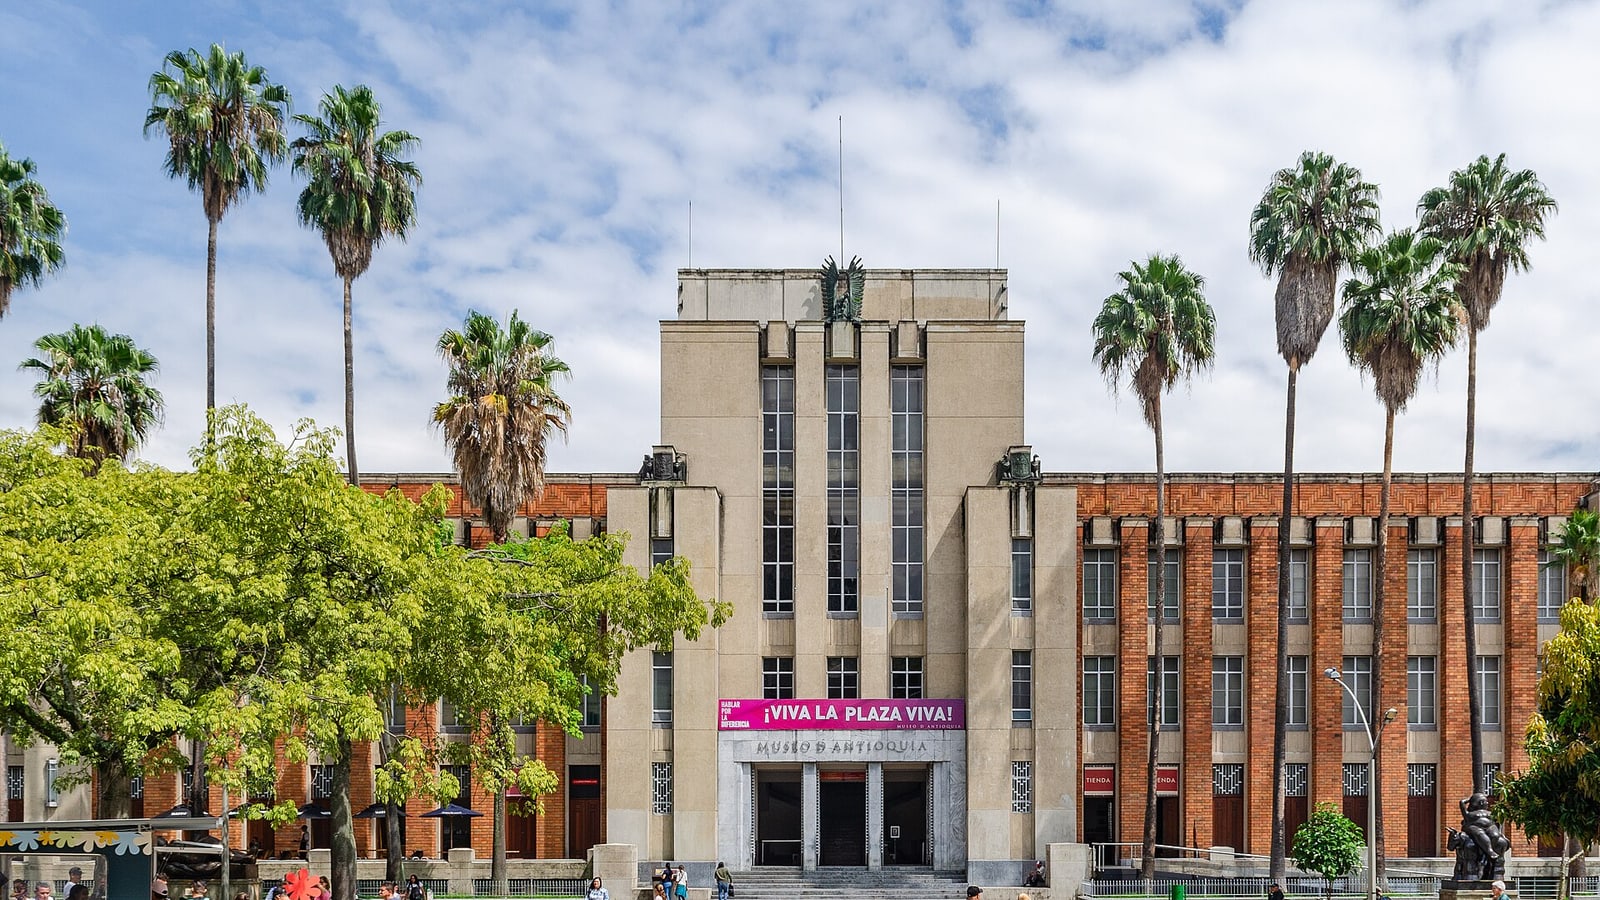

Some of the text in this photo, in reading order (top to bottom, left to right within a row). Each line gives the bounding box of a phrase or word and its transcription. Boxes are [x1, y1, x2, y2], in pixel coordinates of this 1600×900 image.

[764, 705, 953, 723] ¡VIVA LA PLAZA VIVA!
[757, 741, 810, 754] MUSEO
[832, 741, 927, 754] ANTIOQUIA
